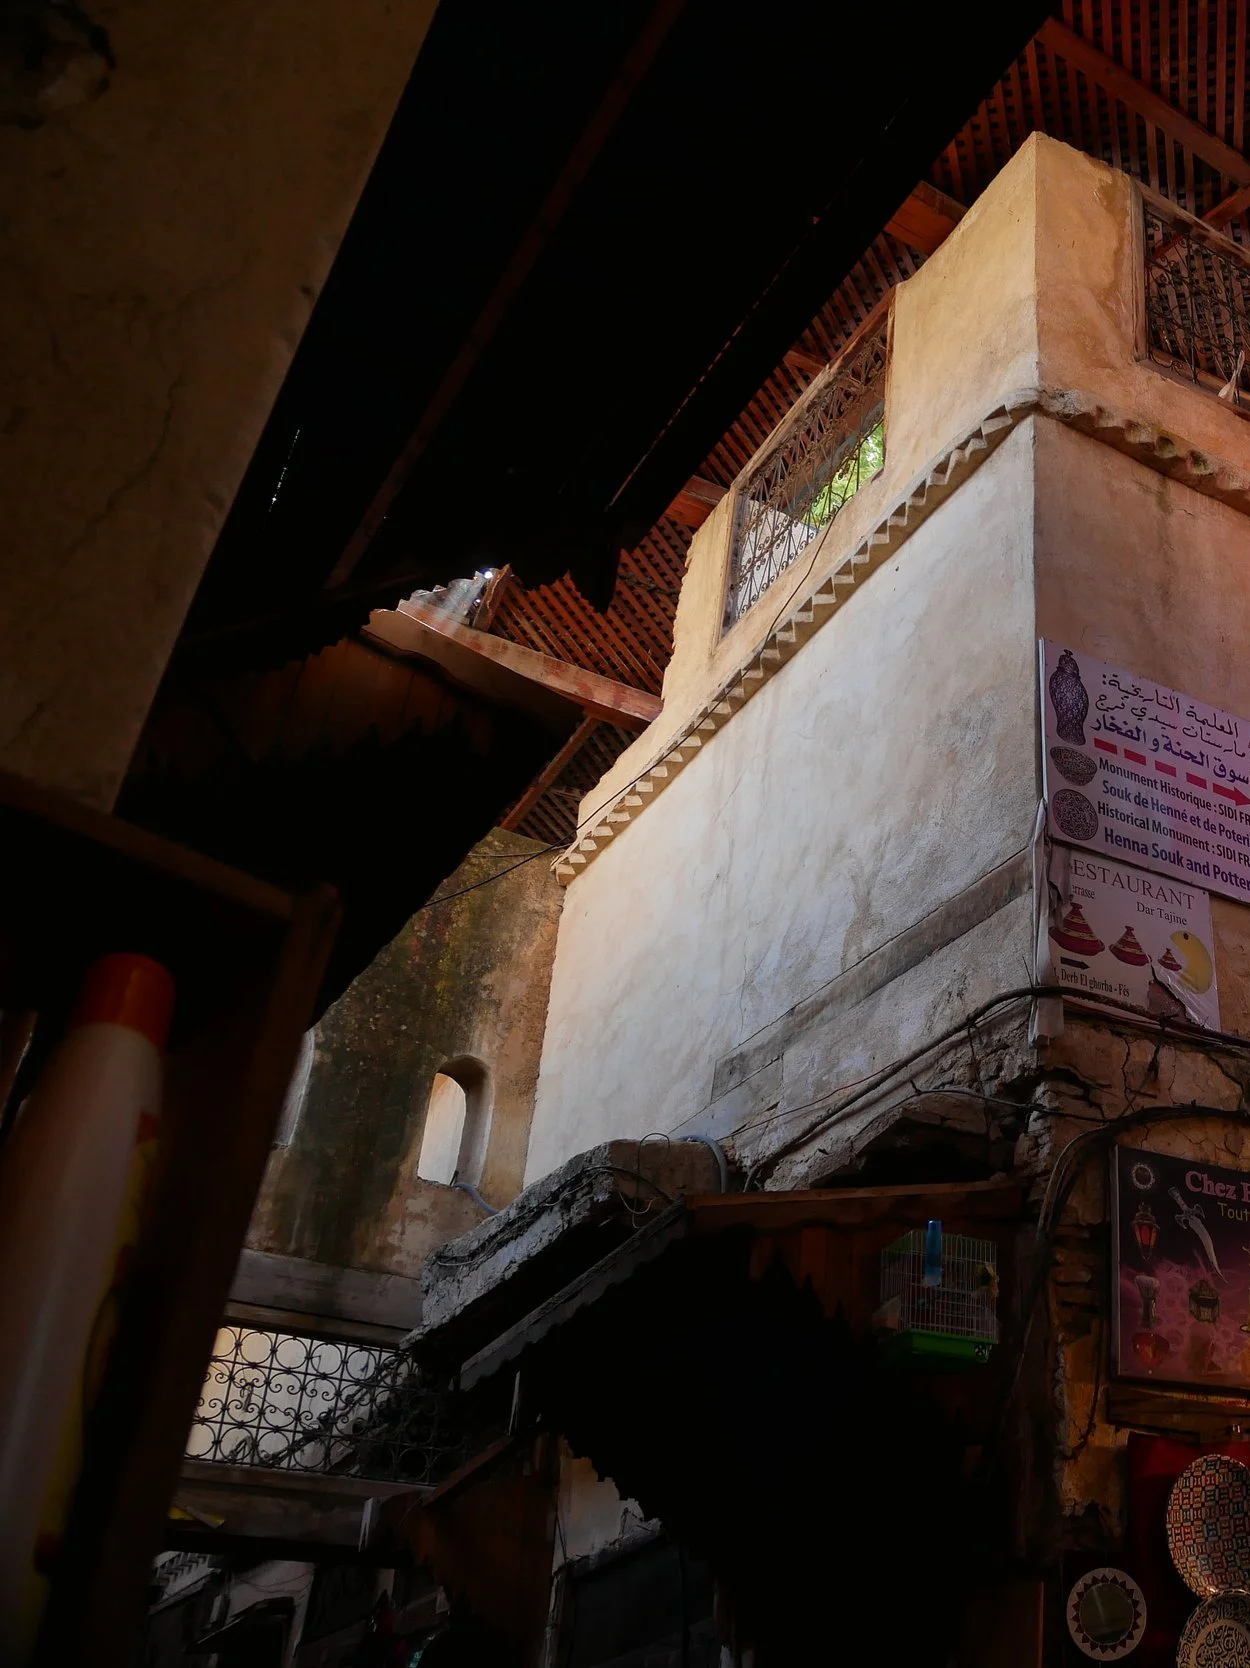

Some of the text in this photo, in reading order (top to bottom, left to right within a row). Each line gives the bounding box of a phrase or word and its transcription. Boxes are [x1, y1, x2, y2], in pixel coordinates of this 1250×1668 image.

[1131, 707, 1177, 730] سيدي
[1186, 705, 1238, 738] المعلمة
[1090, 714, 1249, 785] سوق الحنة و الفخار
[1099, 757, 1158, 790] Monument
[1160, 780, 1212, 812] Historique
[1218, 803, 1238, 821] SIDI
[1102, 780, 1132, 801] Souk
[1133, 792, 1149, 808] de
[1151, 797, 1188, 822] Henné
[1190, 815, 1202, 828] et
[1203, 819, 1217, 834] de
[1097, 801, 1150, 831] Historical
[1152, 820, 1210, 852] Monument
[1217, 844, 1236, 862] SIDI
[1104, 827, 1149, 855] Henna
[1151, 843, 1184, 868] Souk
[1186, 858, 1210, 877] and
[1072, 859, 1195, 910] ESTAURANT
[1072, 884, 1096, 900] rrasse
[1136, 901, 1188, 926] Dar Tajine
[1184, 1170, 1237, 1200] Chez
